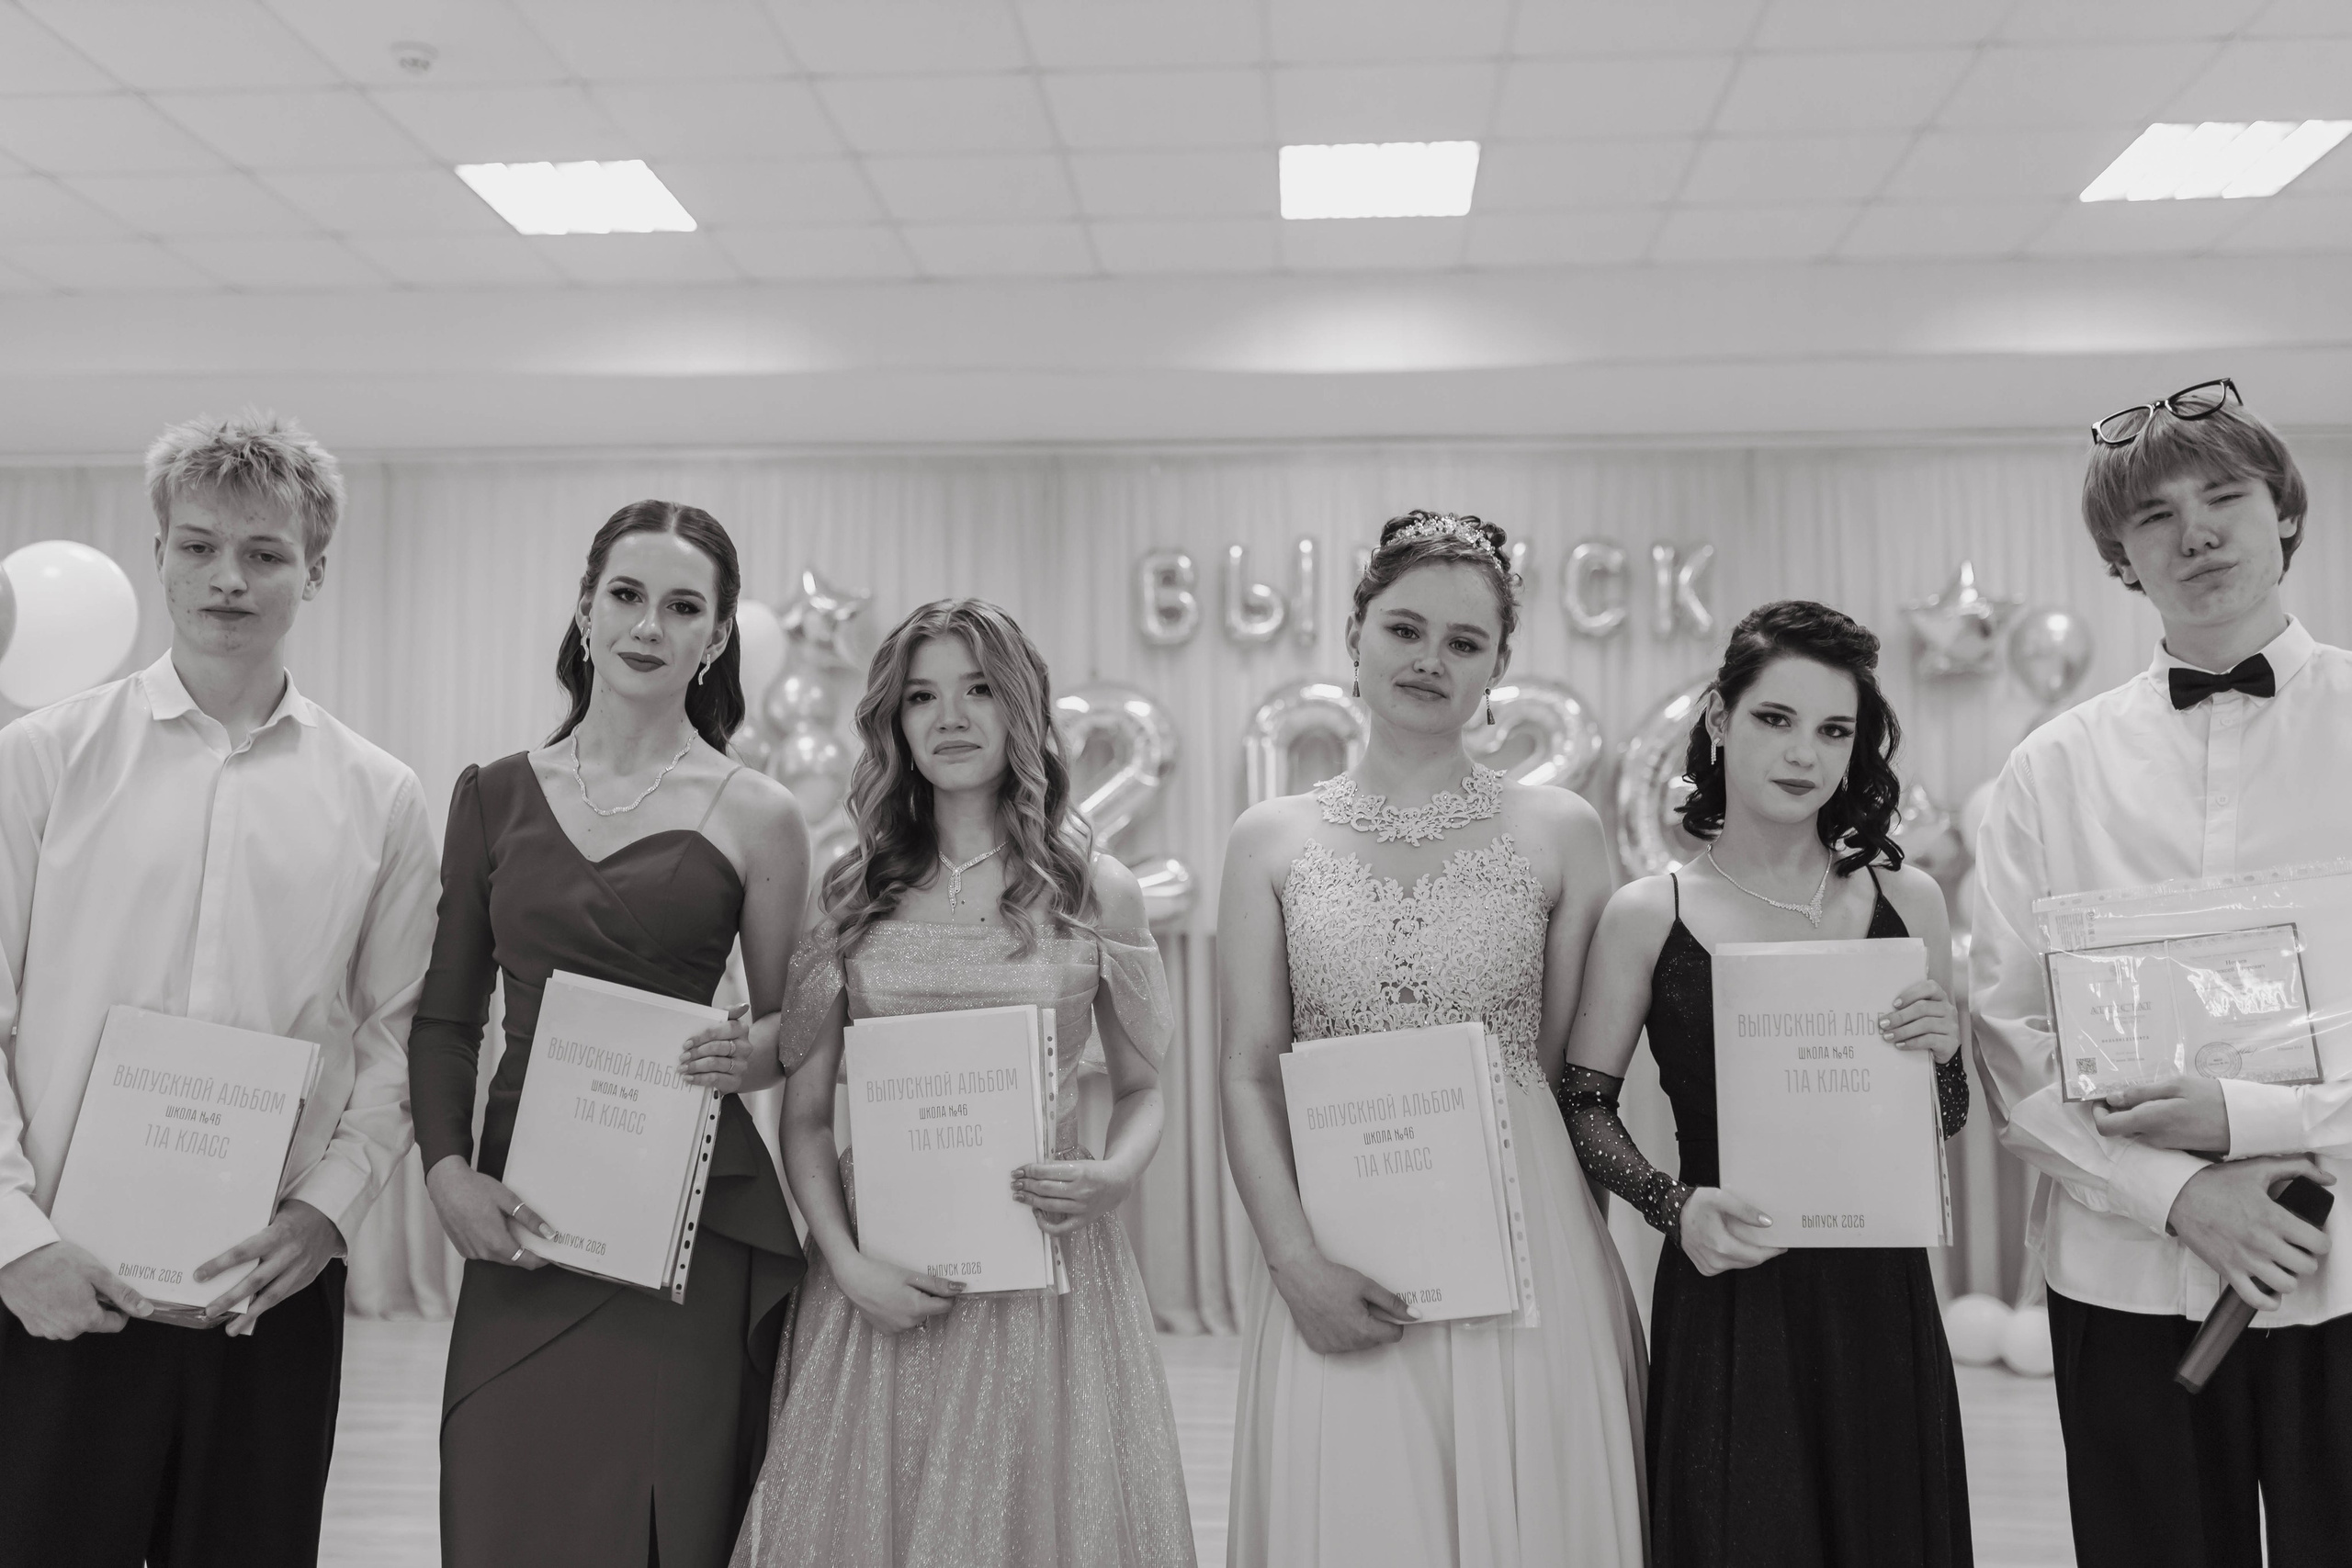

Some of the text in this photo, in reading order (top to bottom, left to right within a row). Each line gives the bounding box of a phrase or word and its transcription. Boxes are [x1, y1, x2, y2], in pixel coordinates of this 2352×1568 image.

[1139, 539, 1715, 642] ВЫСК
[1737, 1010, 1884, 1038] ВЫПУСКНОЙ АЛЬБ
[547, 1037, 632, 1077] ВЫПУСКНОЙ
[1798, 1045, 1854, 1060] ШКОЛА №46
[113, 1065, 286, 1115] ВЫПУСКНОЙ АЛЬБОМ
[591, 1079, 639, 1102] ШКОЛА №46
[866, 1068, 1019, 1102] ВЫПУСКНОЙ АЛЬБОМ
[1784, 1068, 1871, 1093] 11А КЛАСС
[165, 1105, 221, 1126] ШКОЛА №46
[574, 1097, 647, 1135] 11А КЛАСС
[919, 1103, 968, 1120] ШКОЛА №46
[1306, 1087, 1465, 1130] ВЫПУСКНОЙ АЛЬБОМ
[144, 1123, 230, 1158] 11А КЛАСС
[908, 1123, 983, 1152] 11А КЛАСС
[1363, 1126, 1415, 1145] ШКОЛА №46
[1353, 1146, 1433, 1179] 11А КЛАСС
[1802, 1214, 1865, 1228] ВЫПУСК 2026
[553, 1230, 606, 1256] ВЫПУСК 2026
[119, 1262, 183, 1284] ВЫПУСК 2026
[927, 1261, 982, 1277] ВЫПУСК 2026
[1394, 1288, 1442, 1305] УСК 2026
